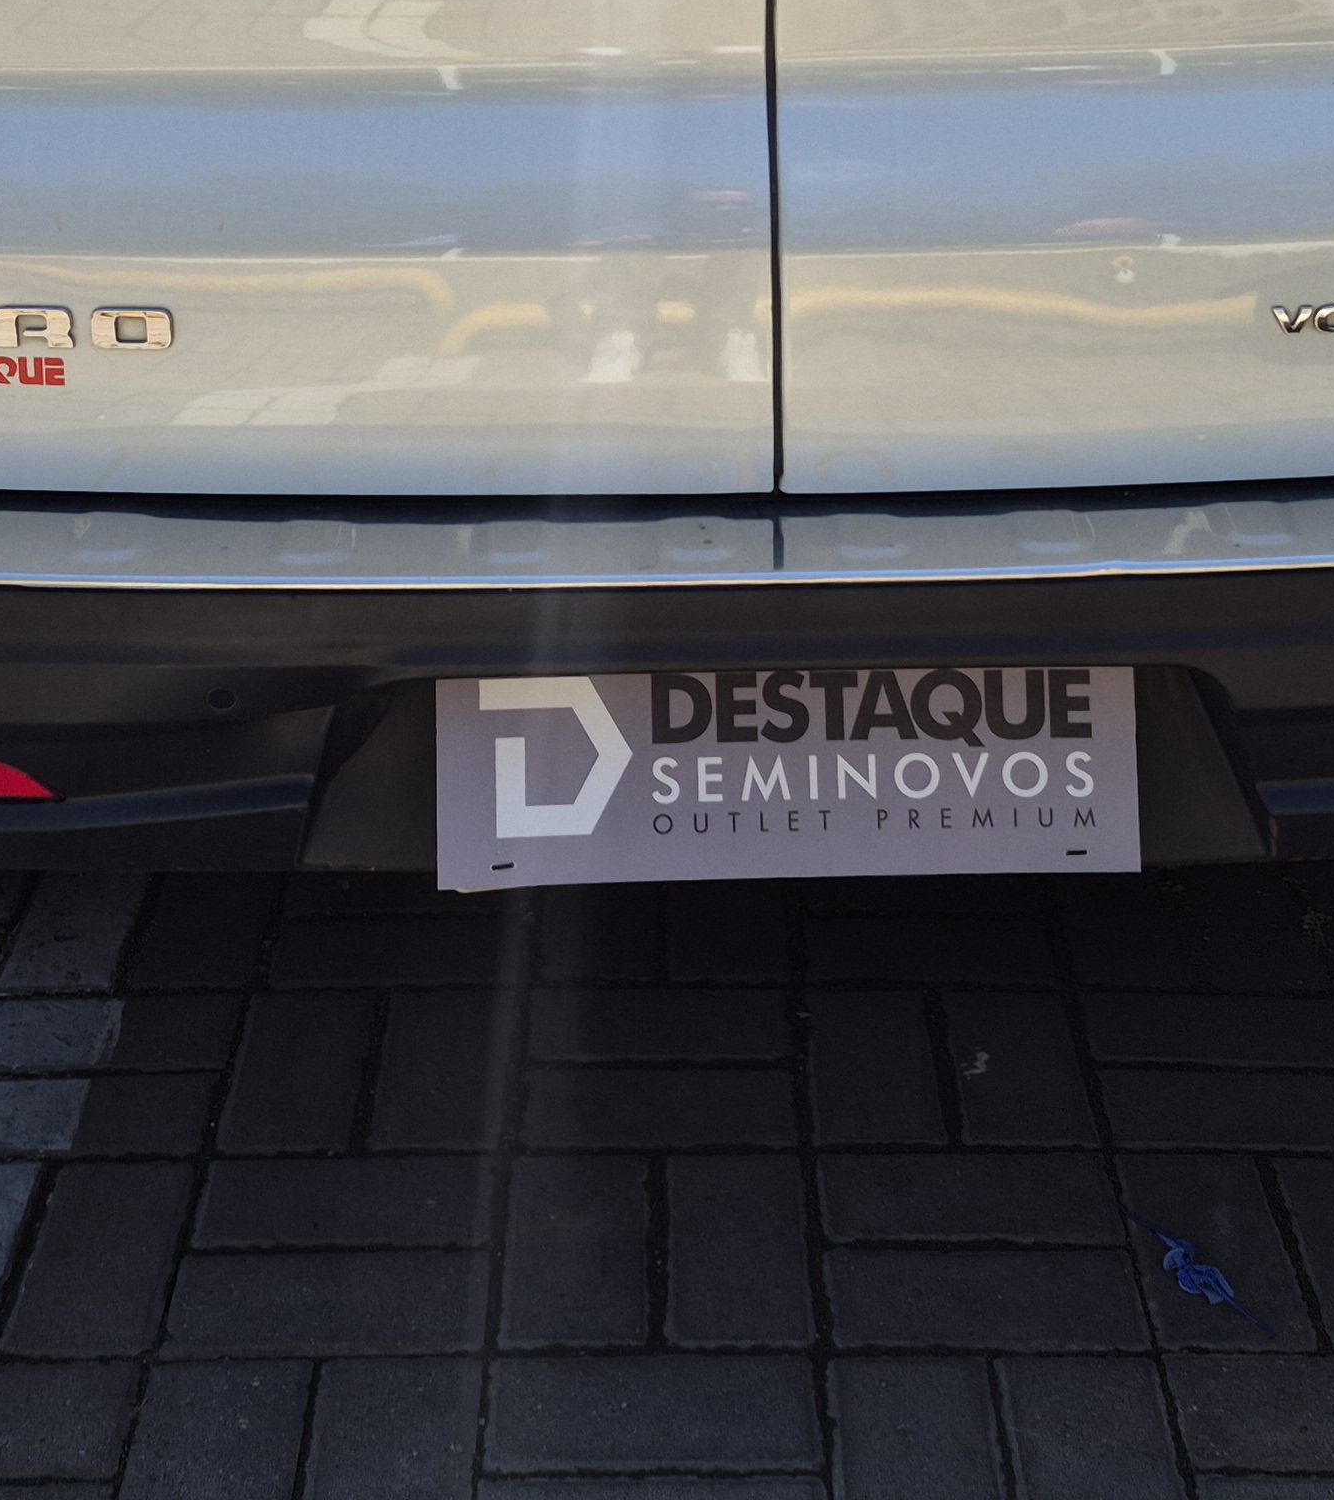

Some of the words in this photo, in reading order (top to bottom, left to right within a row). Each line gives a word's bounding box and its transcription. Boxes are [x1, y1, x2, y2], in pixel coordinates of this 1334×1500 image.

[650, 668, 1093, 747] DESTAQUE
[651, 751, 1095, 804] SEMINOVOS
[653, 810, 833, 836] OUTLET
[876, 807, 1096, 831] PREMIUM
